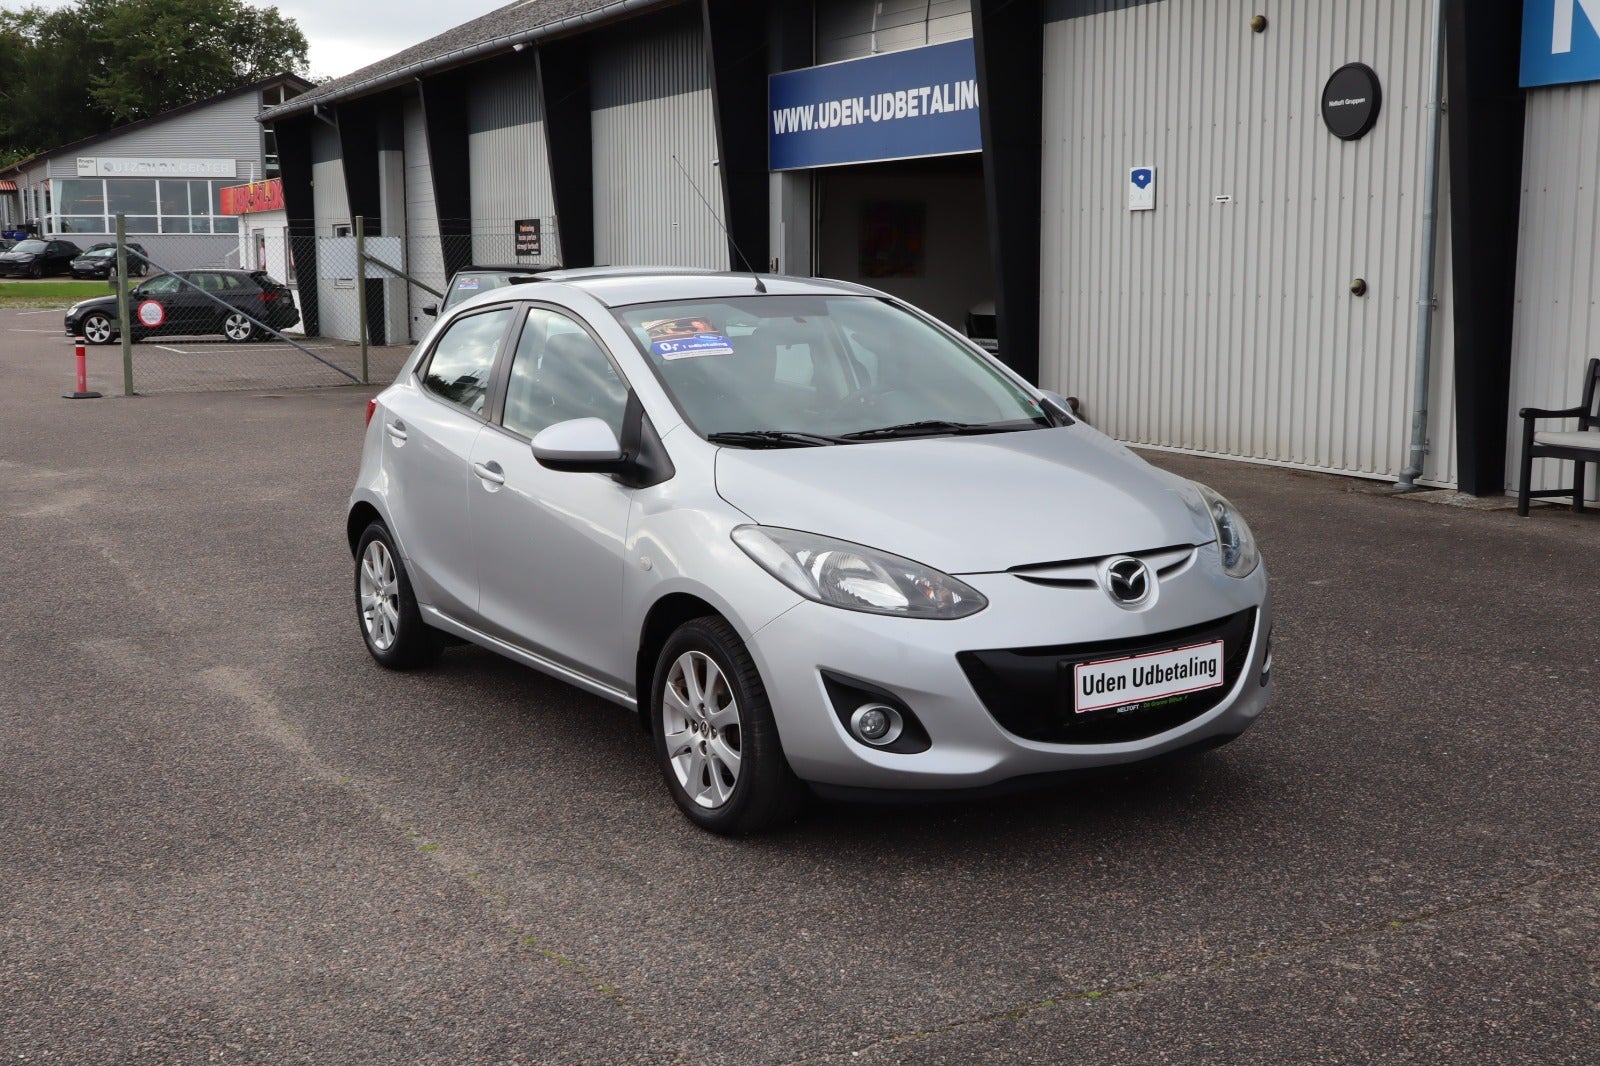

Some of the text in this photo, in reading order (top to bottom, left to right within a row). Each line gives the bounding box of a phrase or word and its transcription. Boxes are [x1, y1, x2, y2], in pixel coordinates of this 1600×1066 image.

[773, 79, 979, 135] WWW.UDEN-UDBETALIN
[1345, 97, 1366, 106] Gruppen
[1082, 656, 1217, 696] Uden Udbetaling
